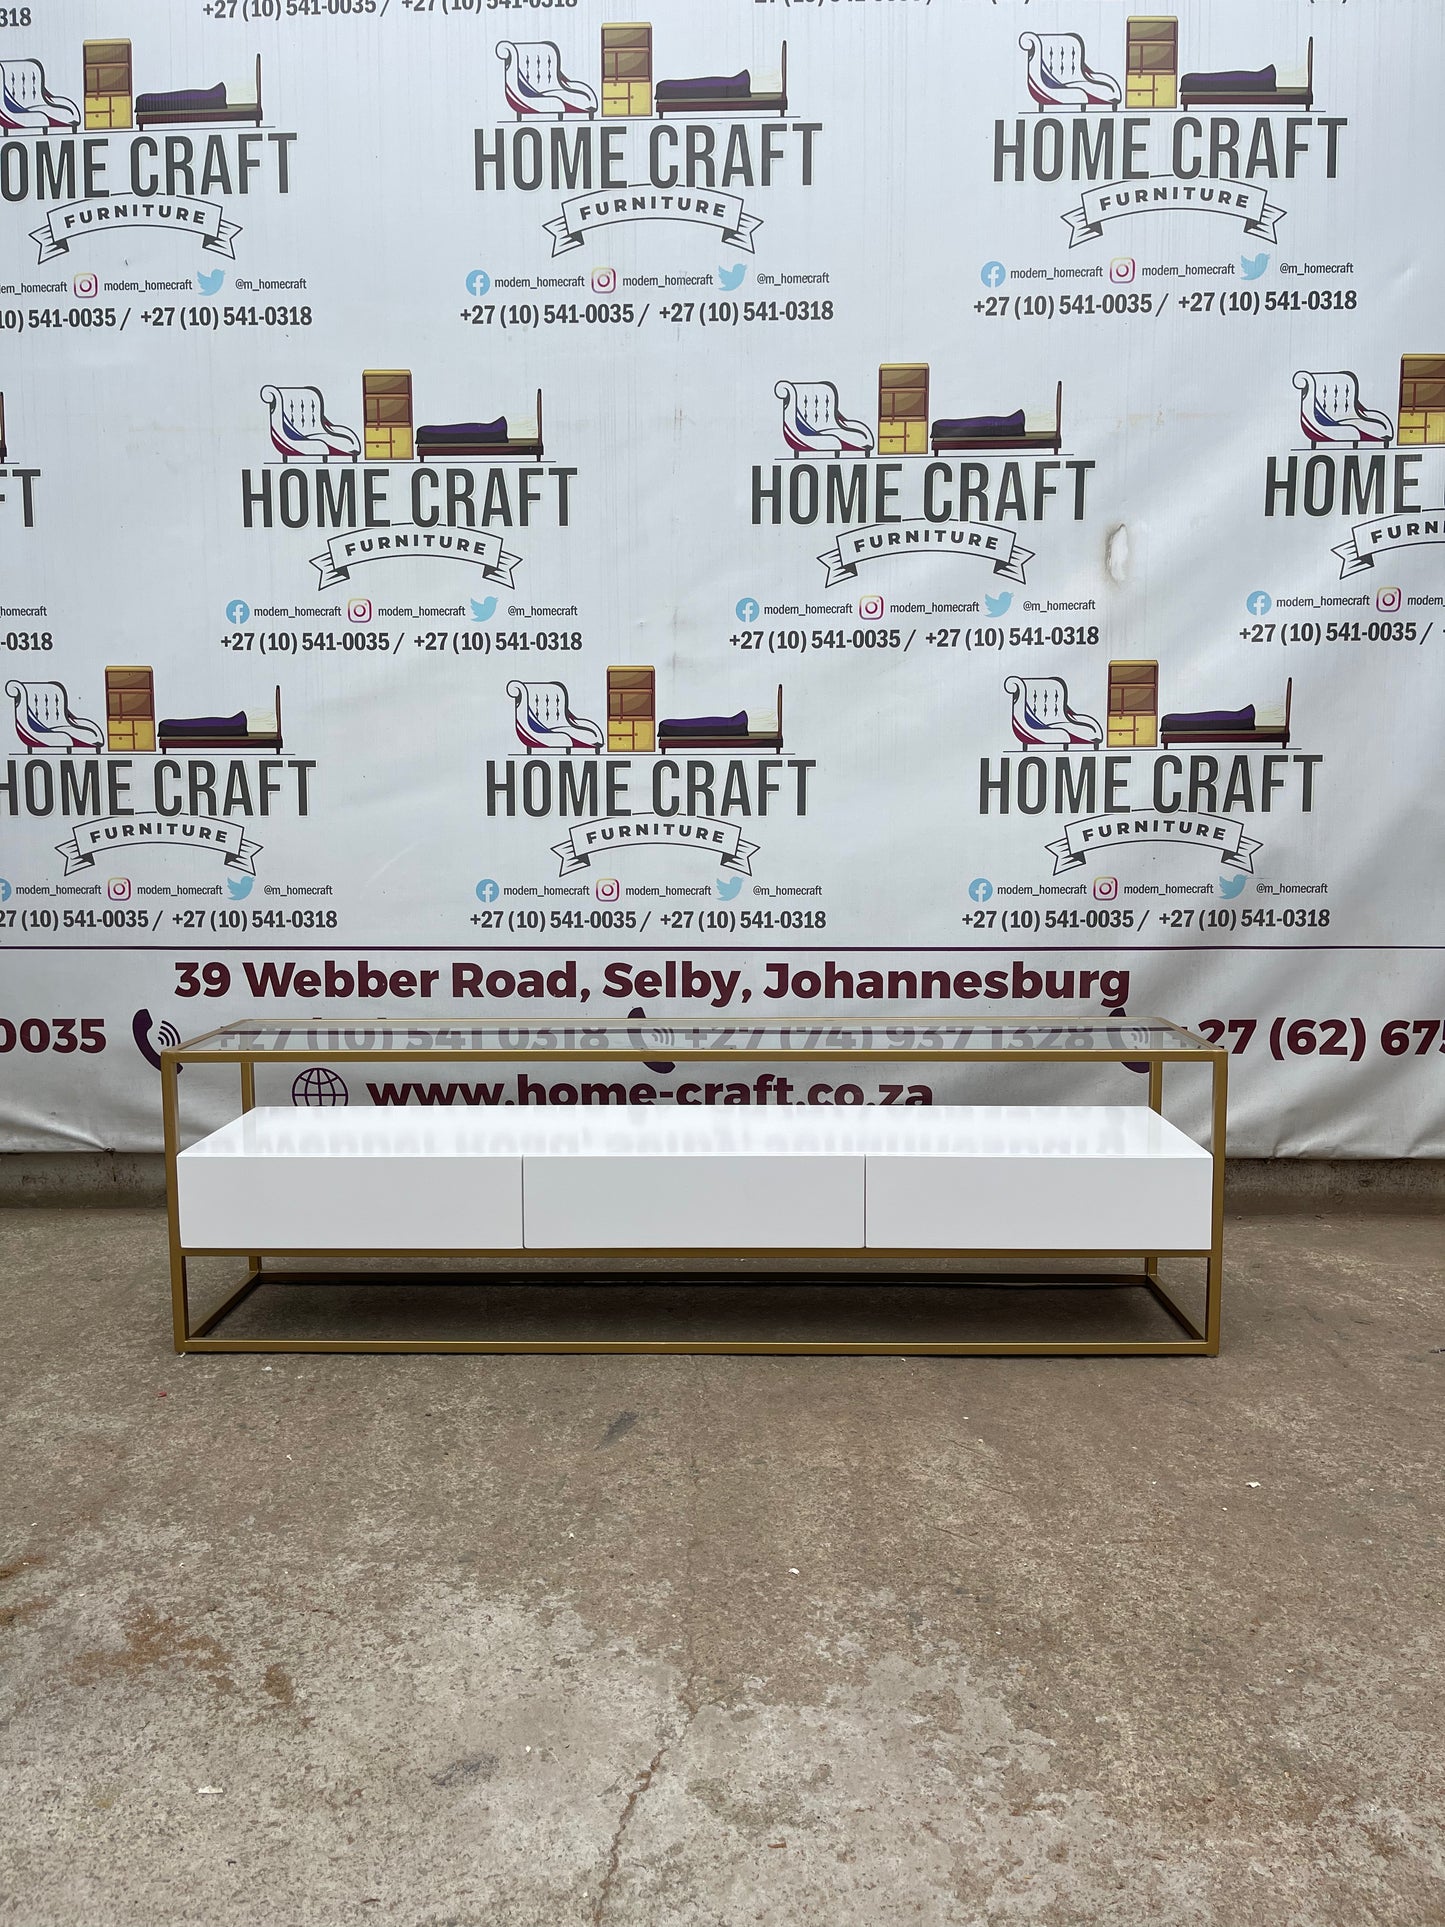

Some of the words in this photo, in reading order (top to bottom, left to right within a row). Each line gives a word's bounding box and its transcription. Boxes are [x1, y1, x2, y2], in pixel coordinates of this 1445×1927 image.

[203, 0, 237, 18] +27
[243, 0, 281, 22] (10)
[475, 126, 627, 191] HOME
[648, 123, 822, 189] CRAFT
[994, 118, 1150, 182] HOME
[1173, 117, 1347, 179] CRAFT
[131, 133, 297, 197] CRAFT
[579, 197, 725, 221] FURNITURE
[1099, 187, 1249, 212] FURNITURE
[64, 203, 206, 228] FURNITURE
[757, 272, 829, 286] @m_homecraft
[1280, 262, 1353, 275] @m_homecraft
[235, 278, 306, 291] @m_homecraft
[460, 305, 495, 324] +27
[500, 305, 539, 328] (10)
[544, 304, 634, 324] 541-0035
[659, 303, 694, 322] +27
[700, 302, 738, 326] (10)
[743, 301, 833, 321] 541-0318
[974, 297, 1009, 316] +27
[1015, 296, 1054, 320] (10)
[1059, 294, 1152, 314] 541-0035
[1179, 292, 1215, 311] +27
[1220, 292, 1259, 315] (10)
[1265, 290, 1357, 311] 541-0318
[28, 308, 116, 328] 541-0035
[141, 307, 175, 326] +27
[180, 307, 218, 330] (10)
[224, 306, 312, 326] 541-0318
[752, 464, 902, 524] HOME
[924, 460, 1095, 523] CRAFT
[1265, 454, 1422, 516] HOME
[242, 468, 390, 528] HOME
[411, 468, 577, 527] CRAFT
[345, 534, 486, 556] FURNITURE
[854, 530, 998, 553] FURNITURE
[508, 605, 578, 618] @m_homecraft
[1023, 600, 1095, 613] @m_homecraft
[221, 633, 254, 650] +27
[260, 633, 297, 655] (10)
[302, 632, 389, 650] 541-0035
[414, 632, 448, 650] +27
[453, 632, 490, 654] (10)
[496, 632, 582, 650] 541-0318
[730, 631, 764, 649] +27
[769, 631, 806, 653] (10)
[811, 629, 900, 649] 541-0035
[926, 629, 960, 647] +27
[965, 628, 1004, 651] (10)
[1009, 626, 1099, 646] 541-0318
[1240, 624, 1276, 642] +27
[1281, 623, 1321, 646] (10)
[1326, 622, 1416, 641] 541-0035
[154, 760, 316, 816] CRAFT
[486, 760, 631, 817] HOME
[653, 760, 816, 817] CRAFT
[980, 756, 1131, 814] HOME
[1153, 755, 1323, 813] CRAFT
[90, 823, 227, 843] FURNITURE
[586, 824, 724, 844] FURNITURE
[1082, 820, 1226, 842] FURNITURE
[264, 885, 333, 897] @m_homecraft
[753, 885, 822, 897] @m_homecraft
[1256, 883, 1328, 895] @m_homecraft
[22, 910, 58, 931] (10)
[63, 910, 148, 927] 541-0035
[172, 910, 205, 927] +27
[211, 910, 247, 932] (10)
[252, 910, 337, 928] 541-0318
[470, 911, 504, 928] +27
[509, 911, 545, 932] (10)
[550, 911, 636, 928] 541-0035
[660, 911, 694, 928] +27
[699, 911, 735, 932] (10)
[740, 911, 826, 928] 541-0318
[962, 910, 997, 928] +27
[1002, 910, 1040, 932] (10)
[1045, 910, 1133, 928] 541-0035
[1159, 910, 1194, 927] +27
[1199, 909, 1236, 931] (10)
[1241, 909, 1330, 927] 541-0318
[174, 962, 230, 997] 39
[242, 960, 439, 998] Webber
[452, 961, 590, 1002] Road,
[603, 961, 751, 1008] Selby,
[763, 961, 1129, 1008] Johannesburg
[1269, 1016, 1367, 1062] (62)
[364, 1072, 935, 1108] www.home-craft.co.za
